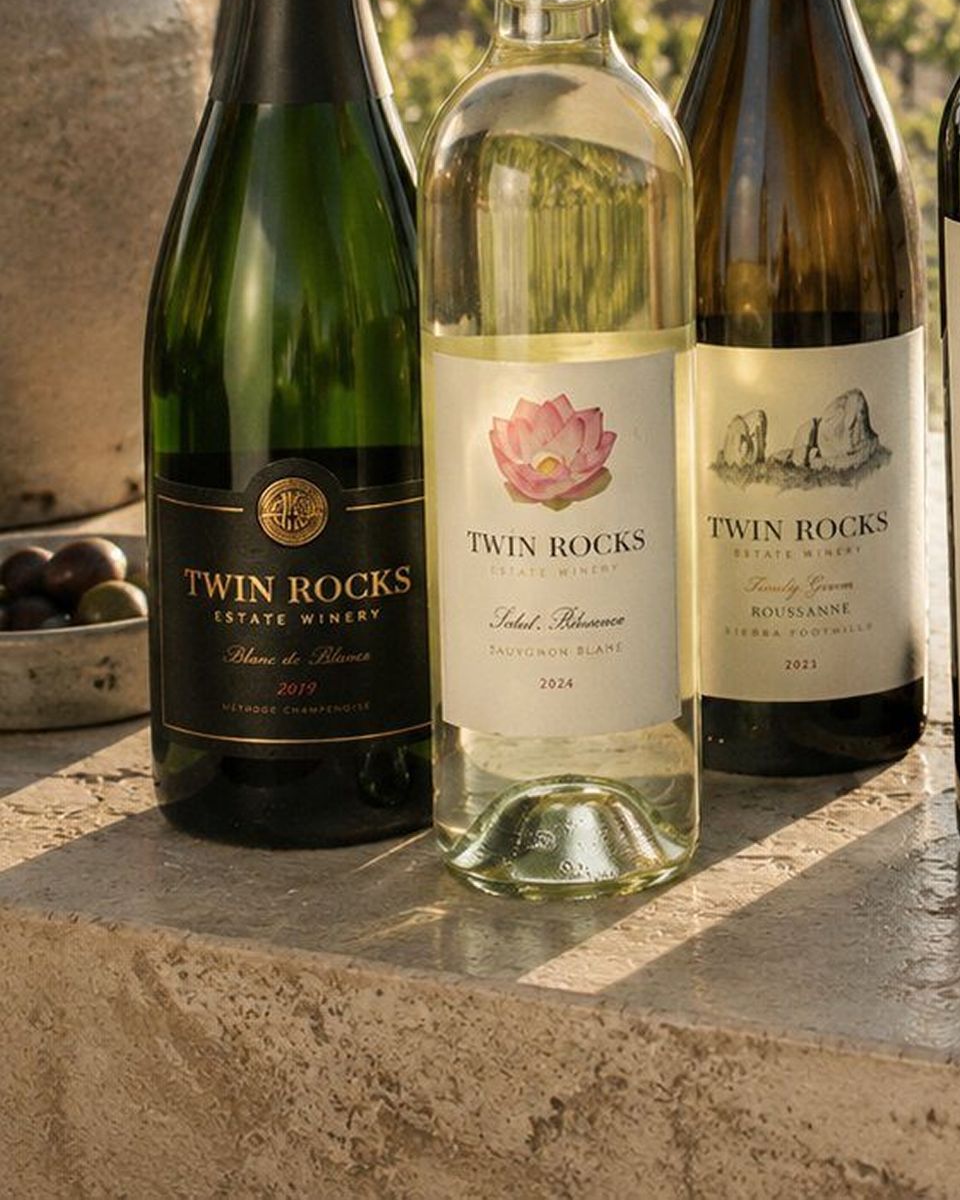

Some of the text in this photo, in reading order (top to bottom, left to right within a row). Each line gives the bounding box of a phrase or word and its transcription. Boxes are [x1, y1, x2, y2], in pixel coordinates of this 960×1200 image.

[707, 511, 889, 542] TWIN ROCKS
[467, 528, 646, 558] TWIN ROCKS
[184, 565, 412, 604] TWIN ROCKS
[214, 608, 381, 626] ESTATE WINERY
[751, 601, 851, 619] ROUSSANNE
[223, 644, 277, 666] Blanc
[281, 650, 299, 666] de
[276, 681, 318, 697] 2019
[539, 677, 574, 689] 2024
